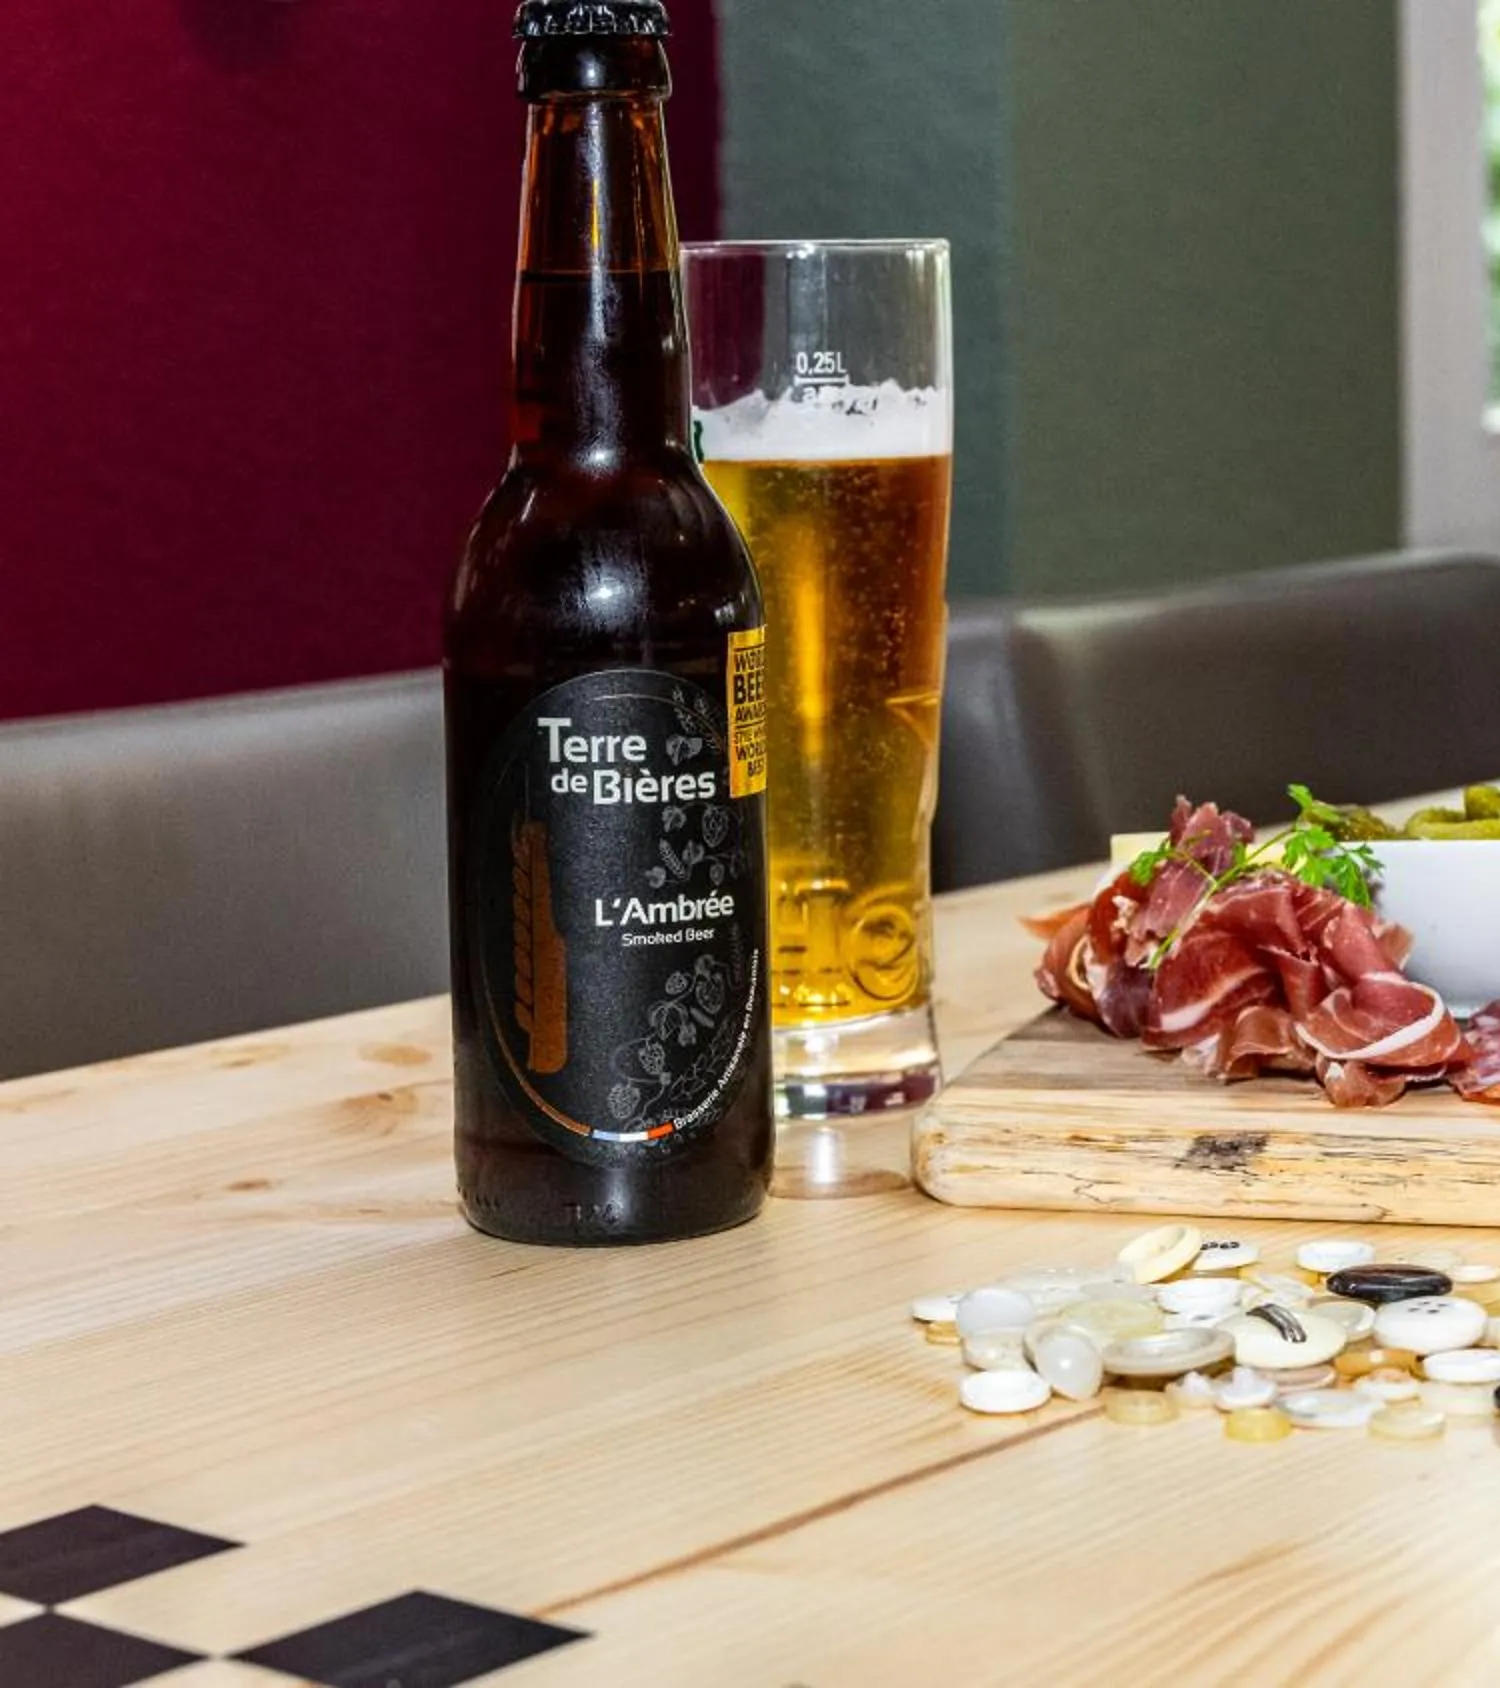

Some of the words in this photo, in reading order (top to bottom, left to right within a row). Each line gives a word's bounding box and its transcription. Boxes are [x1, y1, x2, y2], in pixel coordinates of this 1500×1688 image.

[537, 717, 648, 763] Terre
[551, 768, 588, 793] de
[593, 768, 716, 805] Bières
[595, 890, 735, 927] L'Ambrée
[621, 929, 683, 947] Smoked
[685, 927, 716, 943] Beer
